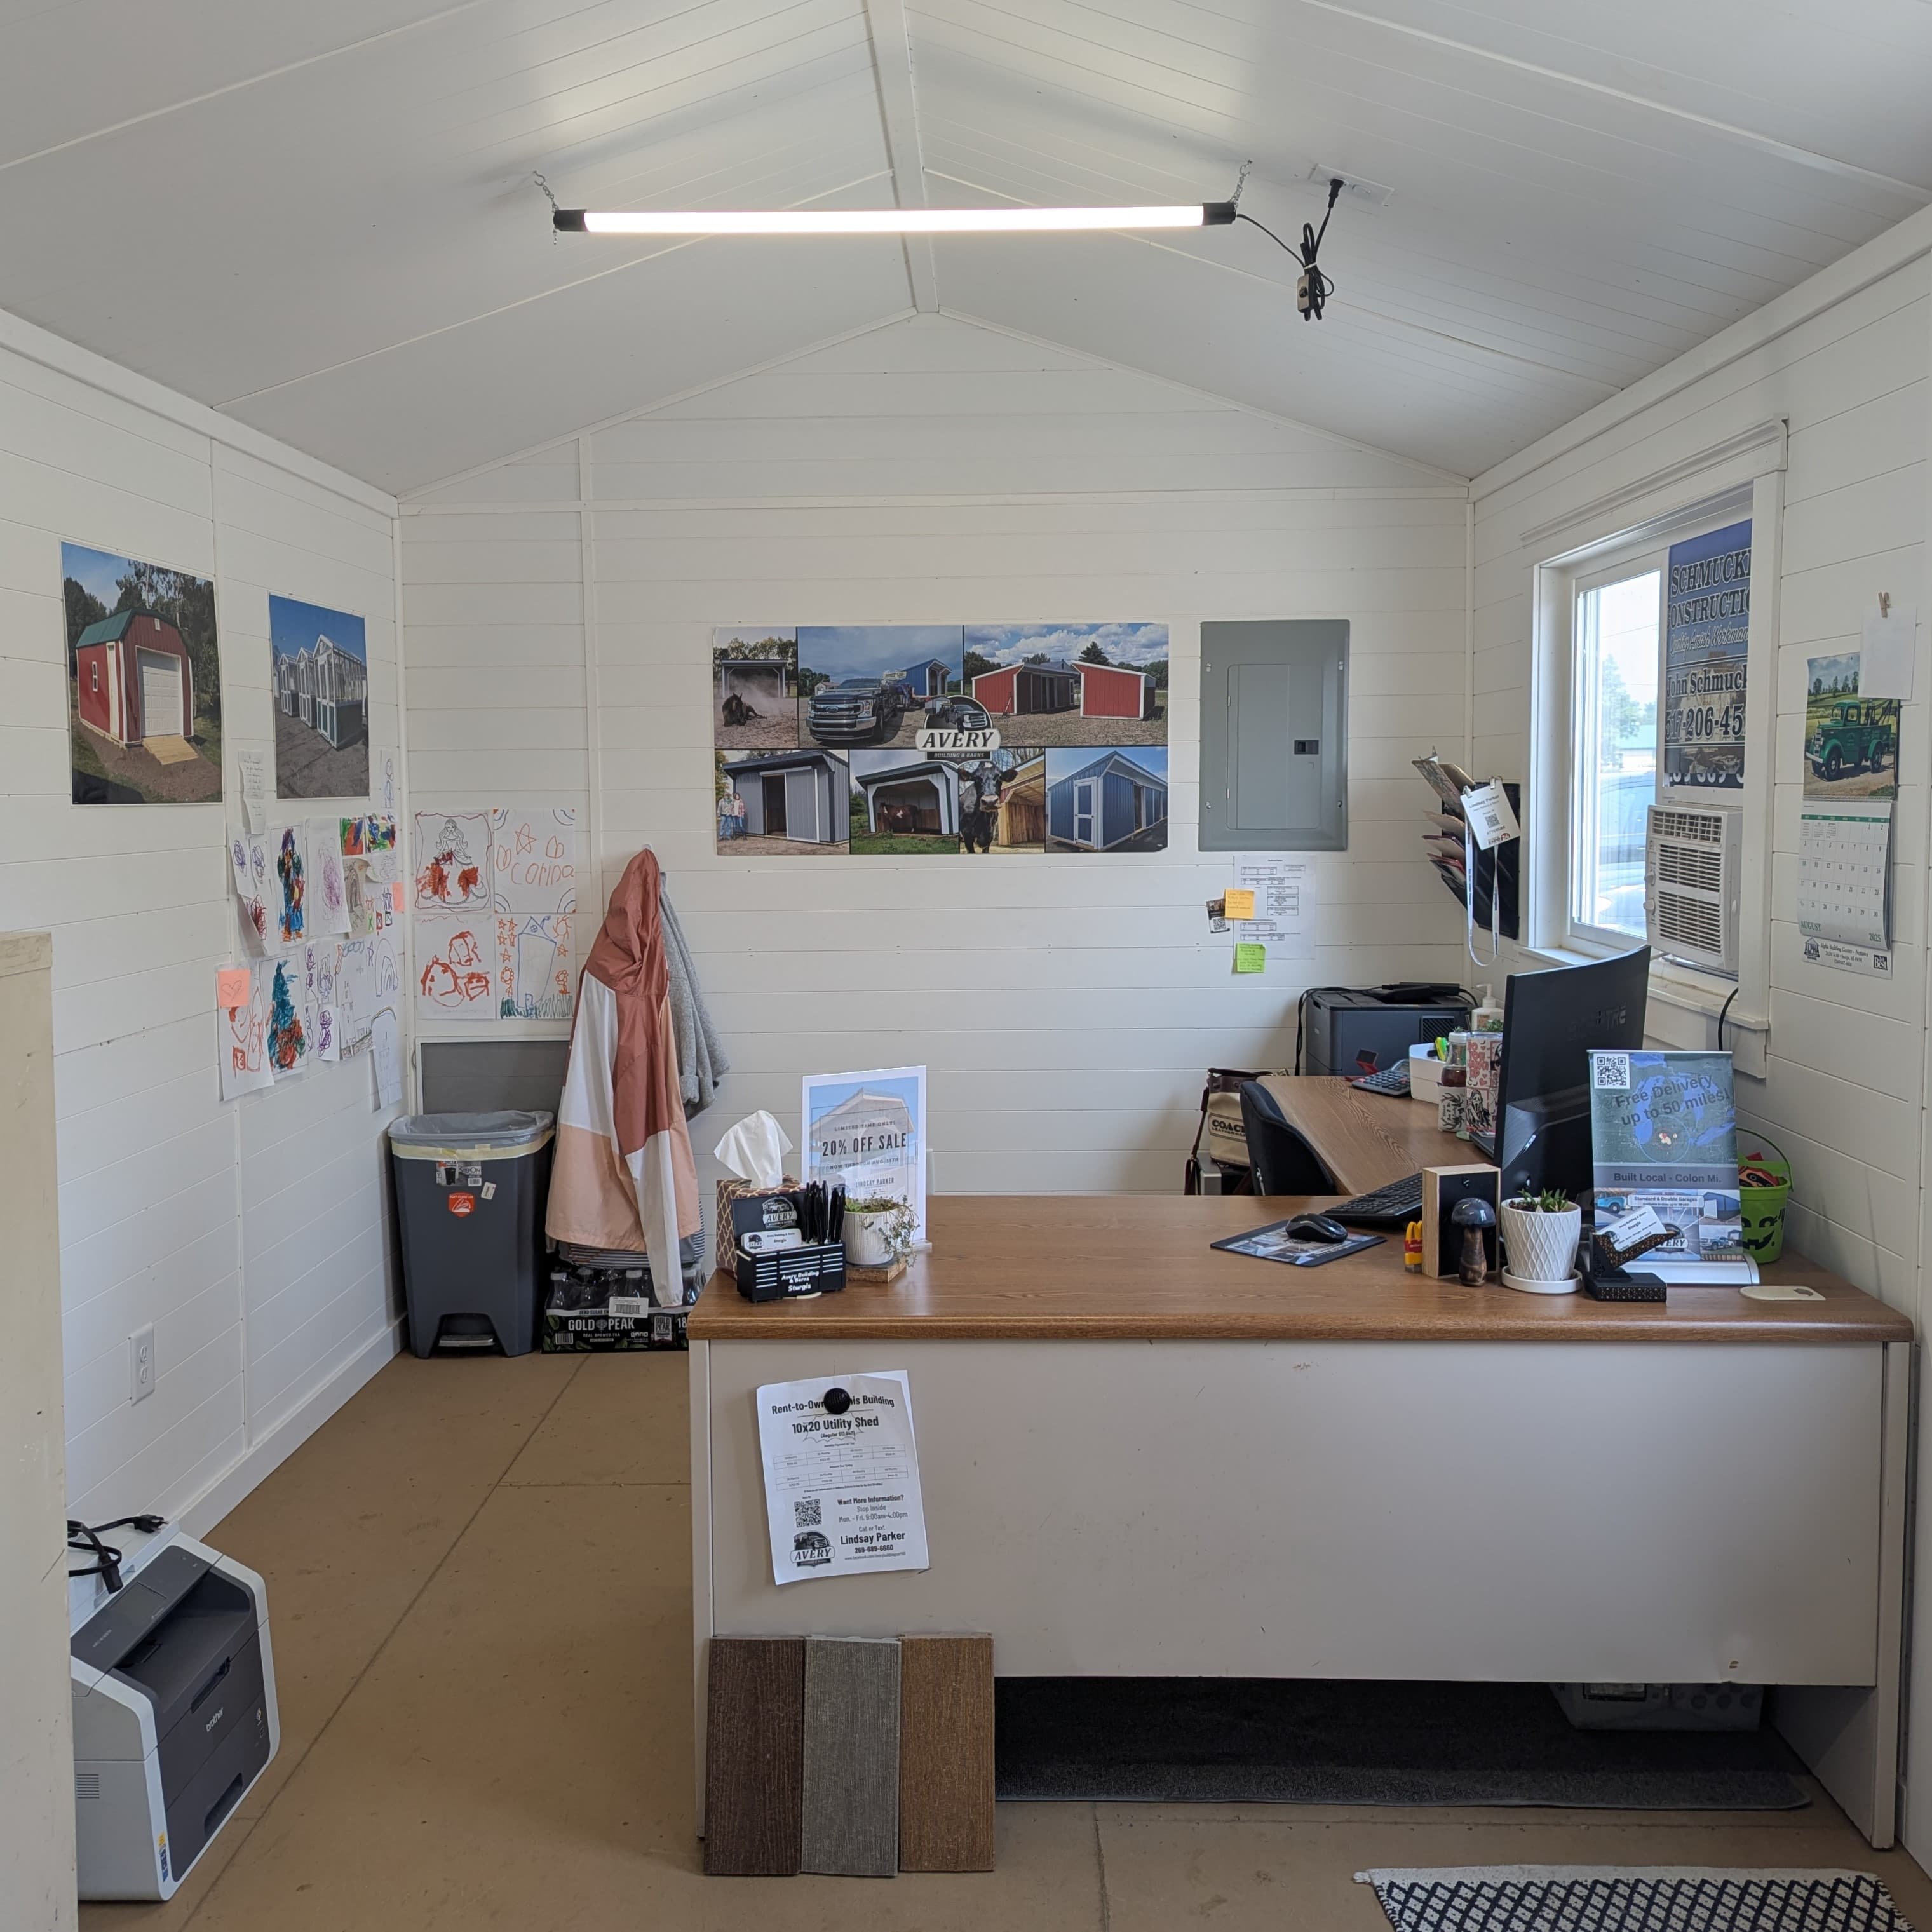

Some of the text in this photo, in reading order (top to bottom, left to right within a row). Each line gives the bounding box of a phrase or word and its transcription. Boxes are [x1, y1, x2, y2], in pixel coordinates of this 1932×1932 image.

[1666, 672, 1688, 698] John
[922, 732, 994, 748] AVERY
[1800, 921, 1821, 931] AUGUST
[1869, 933, 1881, 942] 2025
[1615, 1074, 1713, 1109] Free Delivery
[1621, 1087, 1731, 1126] up to 50 miles!
[822, 1133, 907, 1156] 20% OFF SALE
[1614, 1173, 1637, 1182] Built
[1640, 1173, 1666, 1182] Local
[1675, 1173, 1705, 1182] Colon
[1707, 1174, 1722, 1183] Mi.
[767, 1212, 793, 1222] AVERY
[788, 1283, 811, 1292] Sturgis
[568, 1318, 635, 1331] GOLD PEAK
[863, 1395, 895, 1408] Building
[792, 1416, 879, 1433] 10x20 Utility Shed
[868, 1494, 904, 1503] Information?
[840, 1532, 905, 1545] Lindsay Parker
[795, 1548, 832, 1561] AVERY
[206, 1707, 223, 1732] brother
